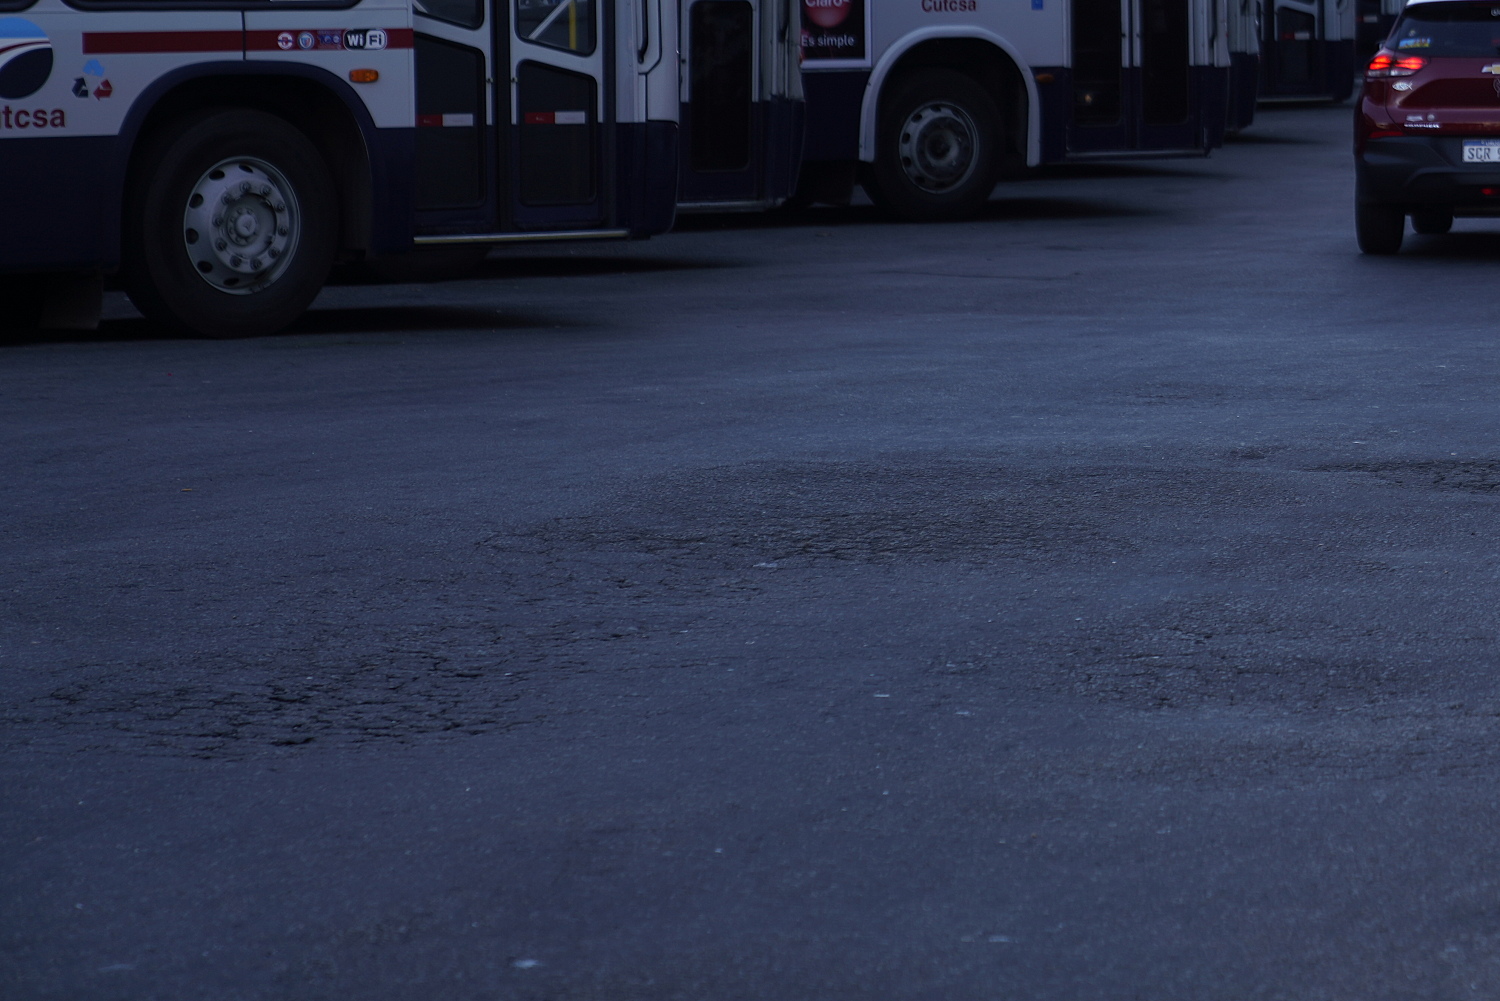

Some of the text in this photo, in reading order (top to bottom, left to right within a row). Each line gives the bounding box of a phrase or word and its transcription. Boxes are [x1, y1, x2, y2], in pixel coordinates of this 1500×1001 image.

[801, 33, 855, 49] Es simple
[0, 105, 66, 130] tcsa
